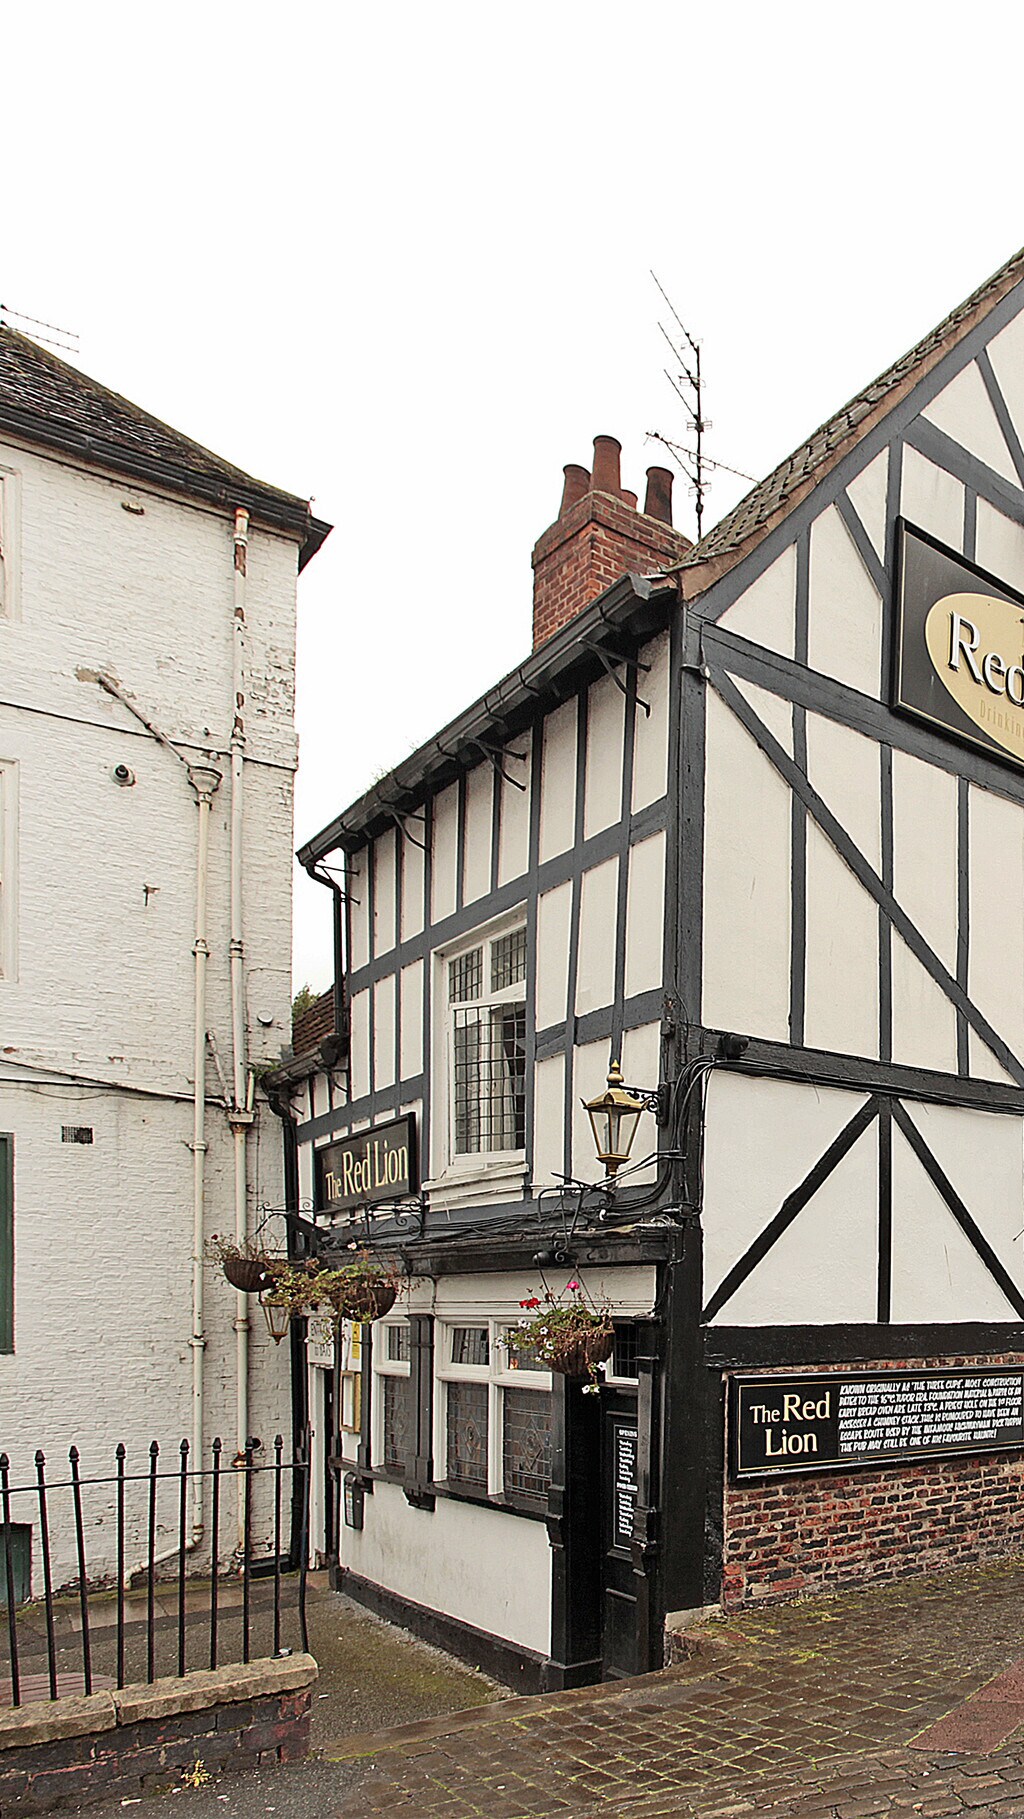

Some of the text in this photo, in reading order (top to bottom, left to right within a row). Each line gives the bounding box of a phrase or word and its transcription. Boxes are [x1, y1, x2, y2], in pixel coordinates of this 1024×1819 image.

[325, 1139, 408, 1200] The Red Lion
[839, 1396, 857, 1407] DATES
[858, 1395, 867, 1405] TO
[867, 1394, 879, 1405] THE
[896, 1393, 915, 1403] TUDOR
[929, 1390, 963, 1401] FOUNDATION
[964, 1389, 987, 1399] MATERIAL
[1008, 1387, 1015, 1396] OF
[1014, 1386, 1022, 1395] AN
[840, 1384, 865, 1395] KNOWN
[866, 1382, 901, 1393] ORIGINALLY
[902, 1382, 910, 1392] AS
[927, 1380, 944, 1390] THREE
[964, 1378, 982, 1388] MOST
[982, 1377, 1021, 1387] CONSTRUCTION
[749, 1391, 831, 1424] The Red
[838, 1407, 857, 1418] EARLY
[857, 1406, 877, 1417] BREAD
[877, 1405, 894, 1415] OVEN
[893, 1404, 906, 1414] ARE
[907, 1403, 922, 1413] LATE
[939, 1401, 943, 1411] A
[944, 1400, 963, 1410] PRIEST
[964, 1399, 978, 1409] HOLE
[979, 1399, 987, 1408] ON
[988, 1398, 997, 1407] THE
[1005, 1397, 1022, 1406] FLOOR
[839, 1418, 867, 1429] ACCESSES
[867, 1417, 872, 1427] A
[873, 1416, 901, 1426] CHIMNEY
[921, 1413, 934, 1423] THIS
[935, 1413, 942, 1422] IS
[942, 1410, 974, 1421] RUMOURED
[975, 1410, 982, 1418] TO
[982, 1409, 996, 1418] HAVE
[997, 1408, 1010, 1416] BEEN
[1011, 1407, 1019, 1416] AN
[840, 1417, 1022, 1441] ESCAPE ROUTE USED BY THE INFAMOUS HIGHWAYMAN DICK TURPIN
[840, 1442, 853, 1452] THE
[853, 1440, 867, 1451] PUB
[867, 1440, 882, 1450] MAY
[883, 1439, 898, 1449] STILL
[899, 1437, 908, 1447] BE
[909, 1436, 922, 1446] ONE
[922, 1435, 931, 1445] OF
[942, 1432, 972, 1443] FAVOURITE
[973, 1429, 997, 1439] HAUNTS!
[765, 1428, 818, 1456] Lion
